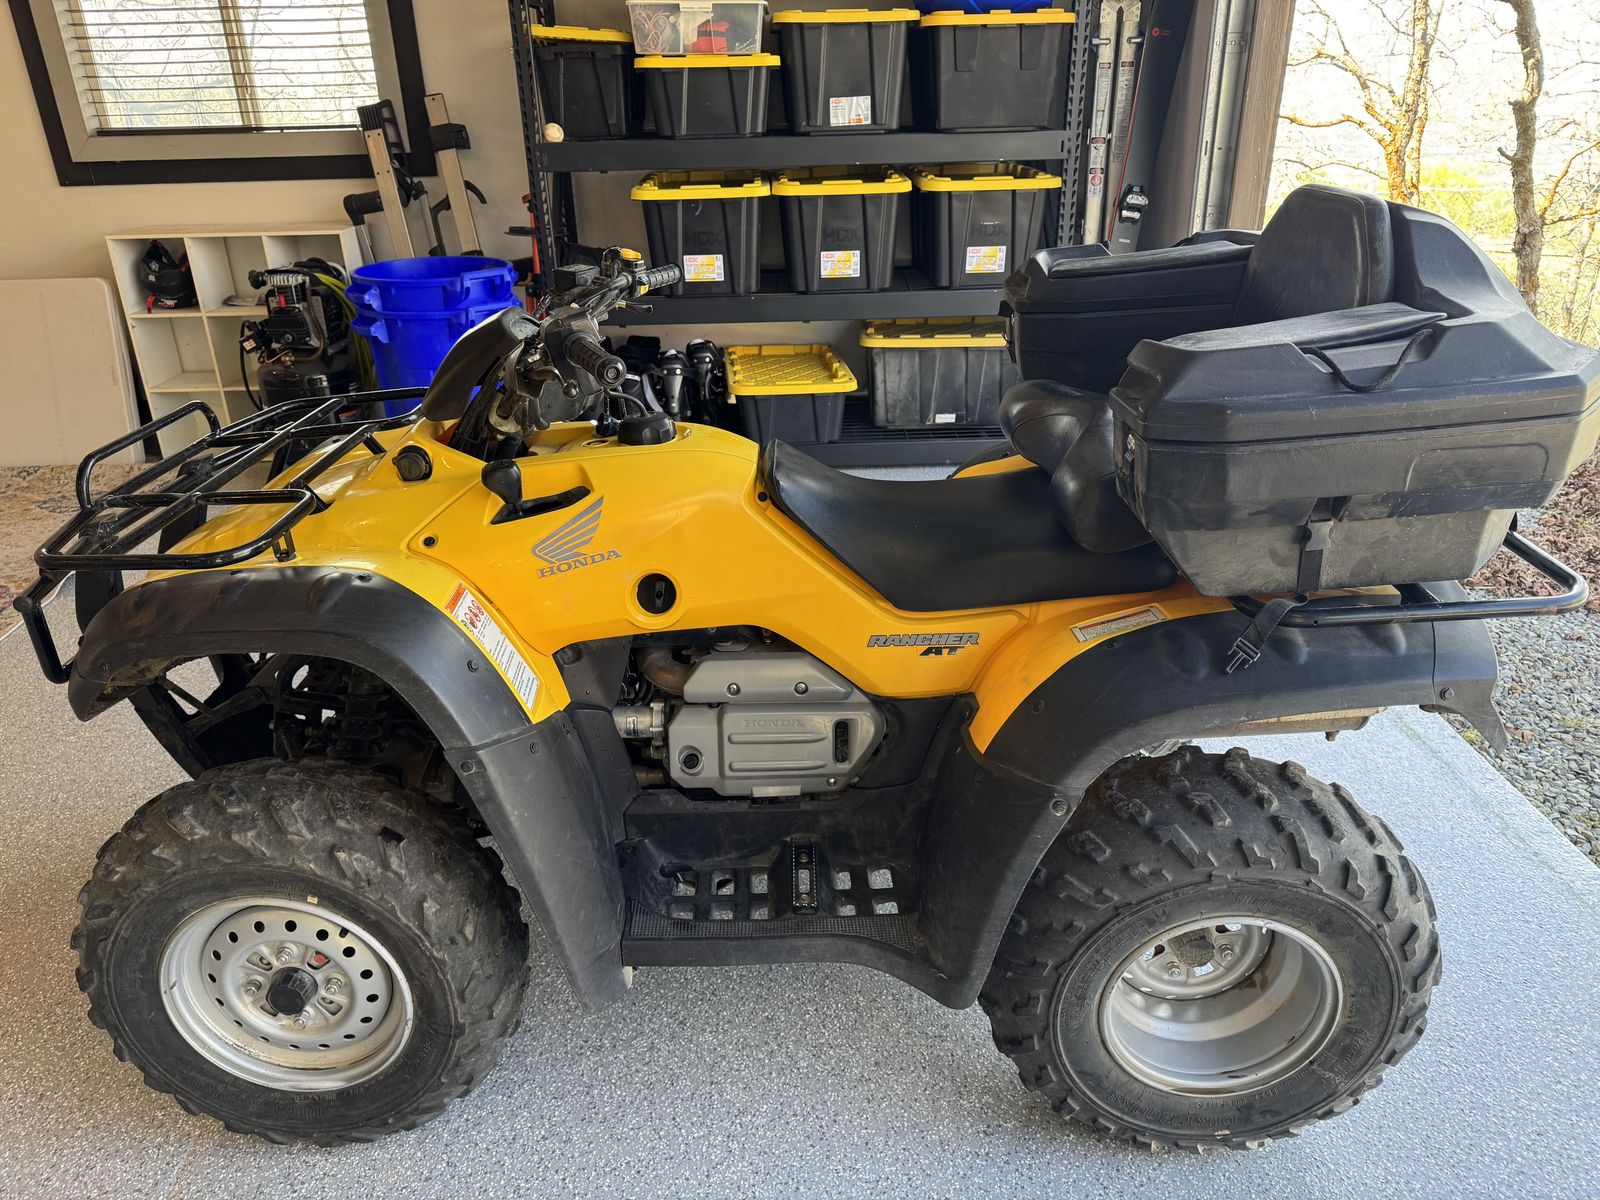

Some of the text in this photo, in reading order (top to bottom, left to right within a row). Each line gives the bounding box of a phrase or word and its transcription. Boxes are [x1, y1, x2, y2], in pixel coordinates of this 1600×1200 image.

[824, 227, 860, 243] HDX
[971, 223, 1007, 238] HDX
[685, 231, 722, 247] HDX
[538, 549, 623, 578] HONDA
[866, 632, 979, 648] RANCHER
[919, 645, 965, 656] AT
[743, 719, 804, 729] HONDA
